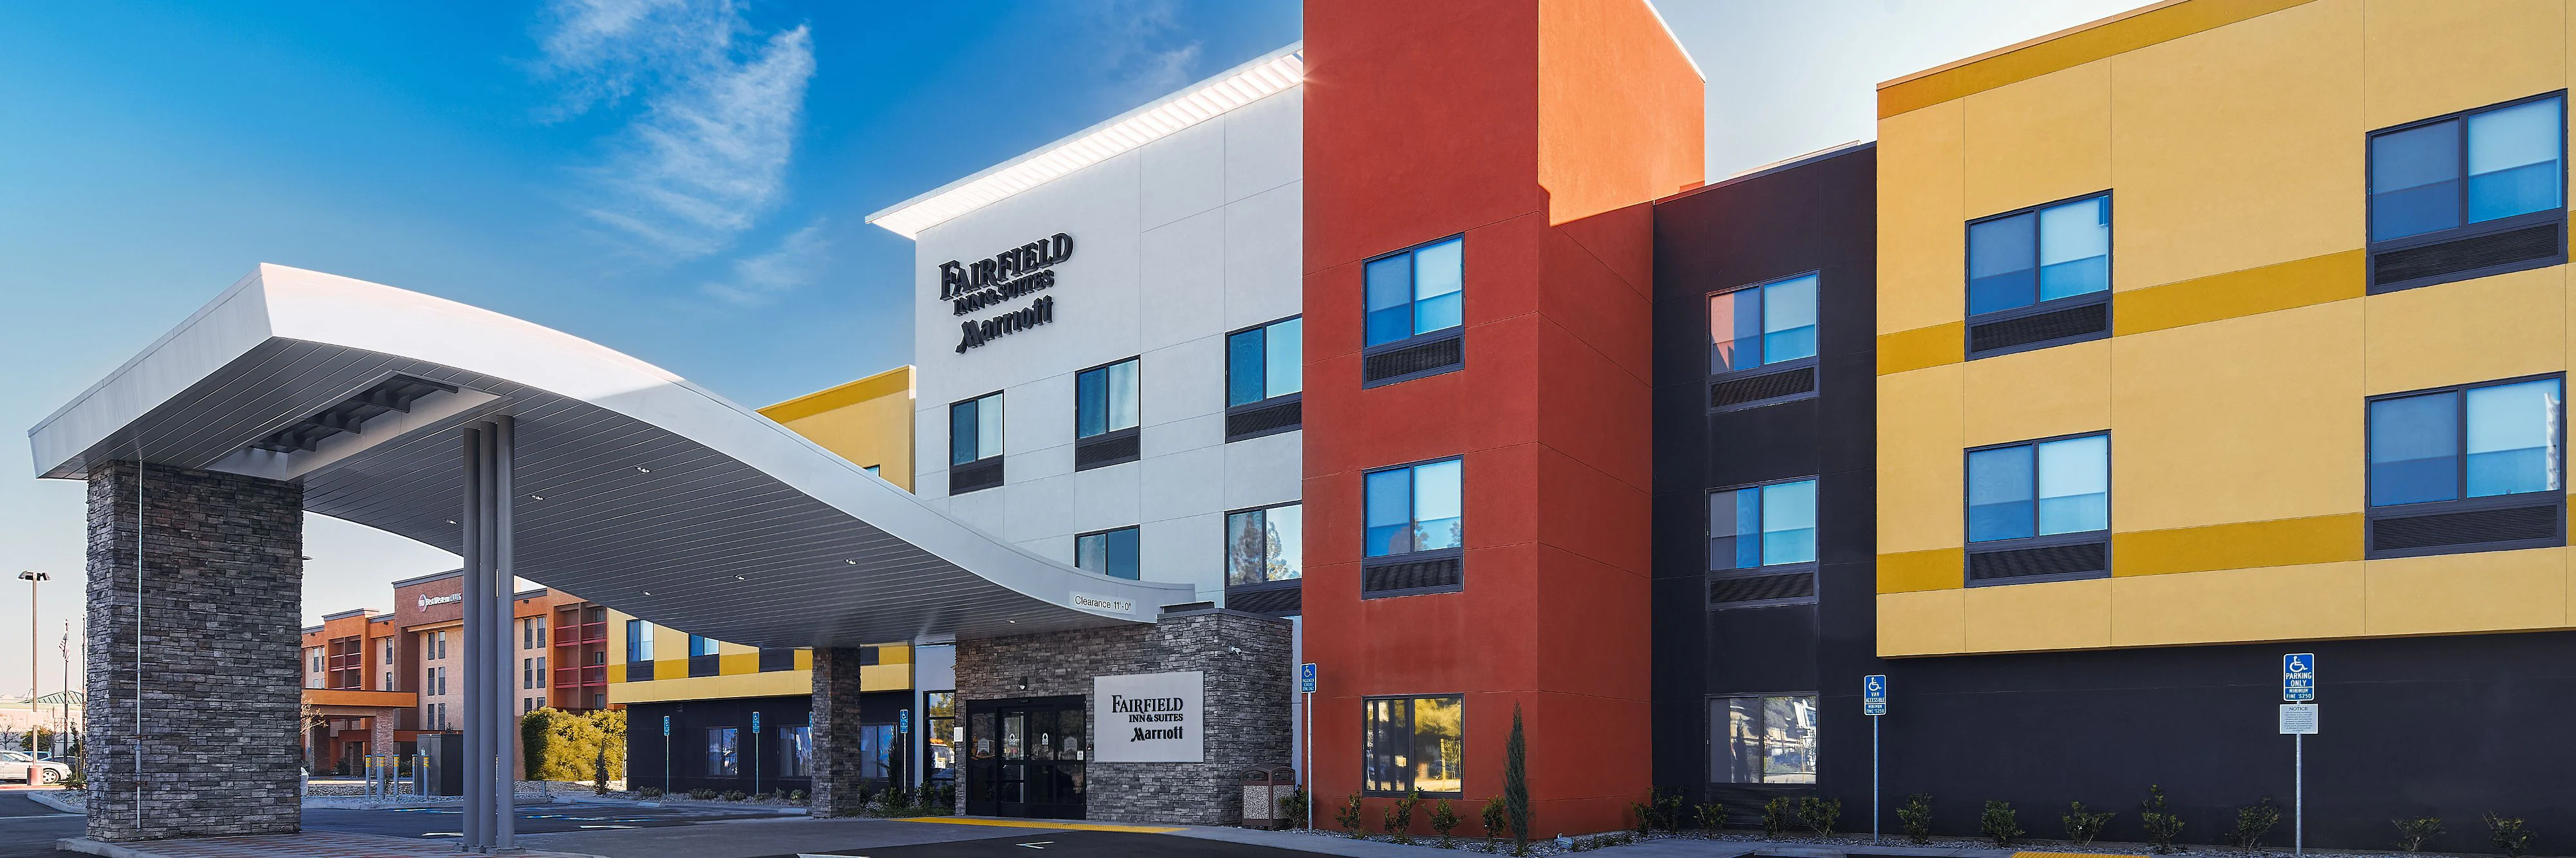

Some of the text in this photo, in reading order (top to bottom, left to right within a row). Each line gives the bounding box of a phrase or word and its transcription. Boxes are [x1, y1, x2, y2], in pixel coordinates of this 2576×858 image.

[939, 232, 1074, 301] FAIRFIELD
[955, 294, 1054, 354] Marriott
[1075, 595, 1111, 608] Clearance
[1112, 695, 1184, 714] FAIRFIELD
[1130, 726, 1183, 741] Marriott
